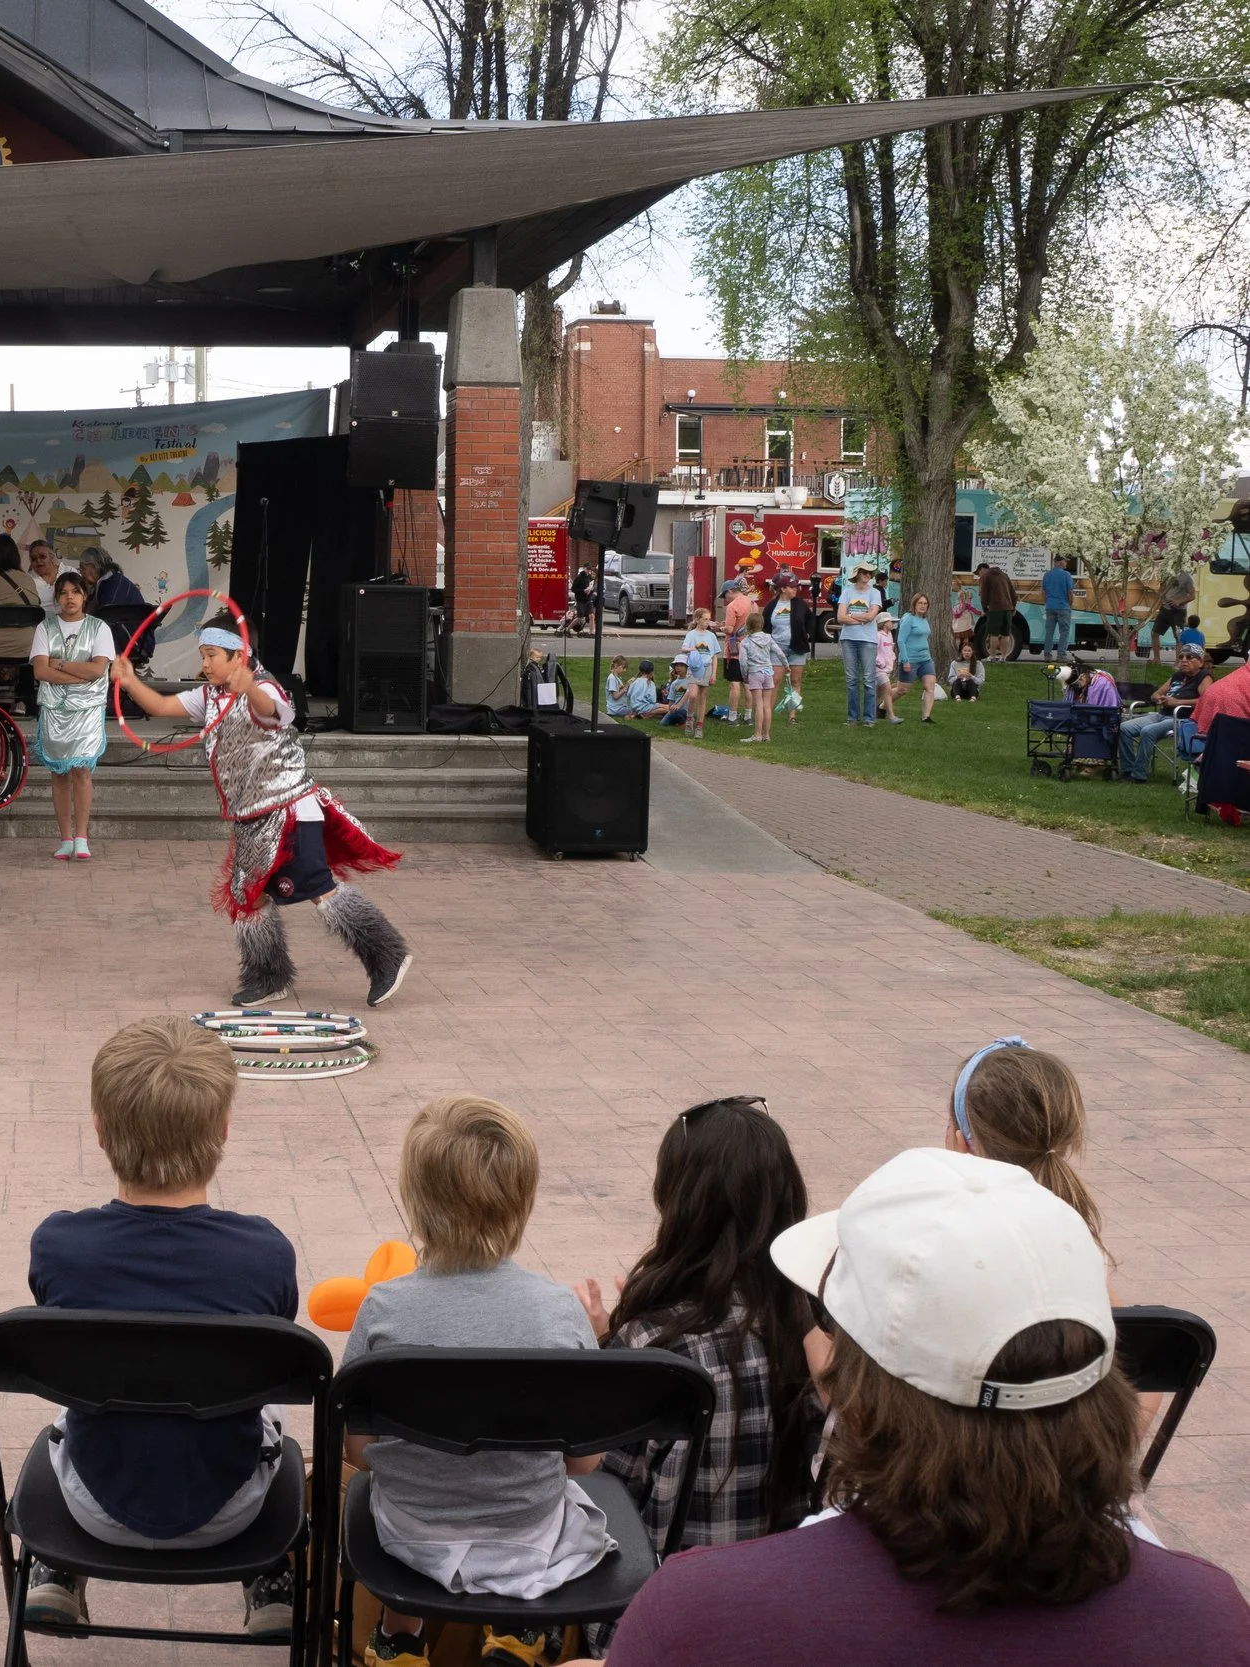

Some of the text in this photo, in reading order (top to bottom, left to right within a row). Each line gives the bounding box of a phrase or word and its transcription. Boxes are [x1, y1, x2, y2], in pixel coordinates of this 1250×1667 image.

[154, 437, 198, 449] Festival
[978, 538, 989, 546] ICE
[989, 537, 1014, 547] CREAM
[982, 1388, 993, 1407] TGR
